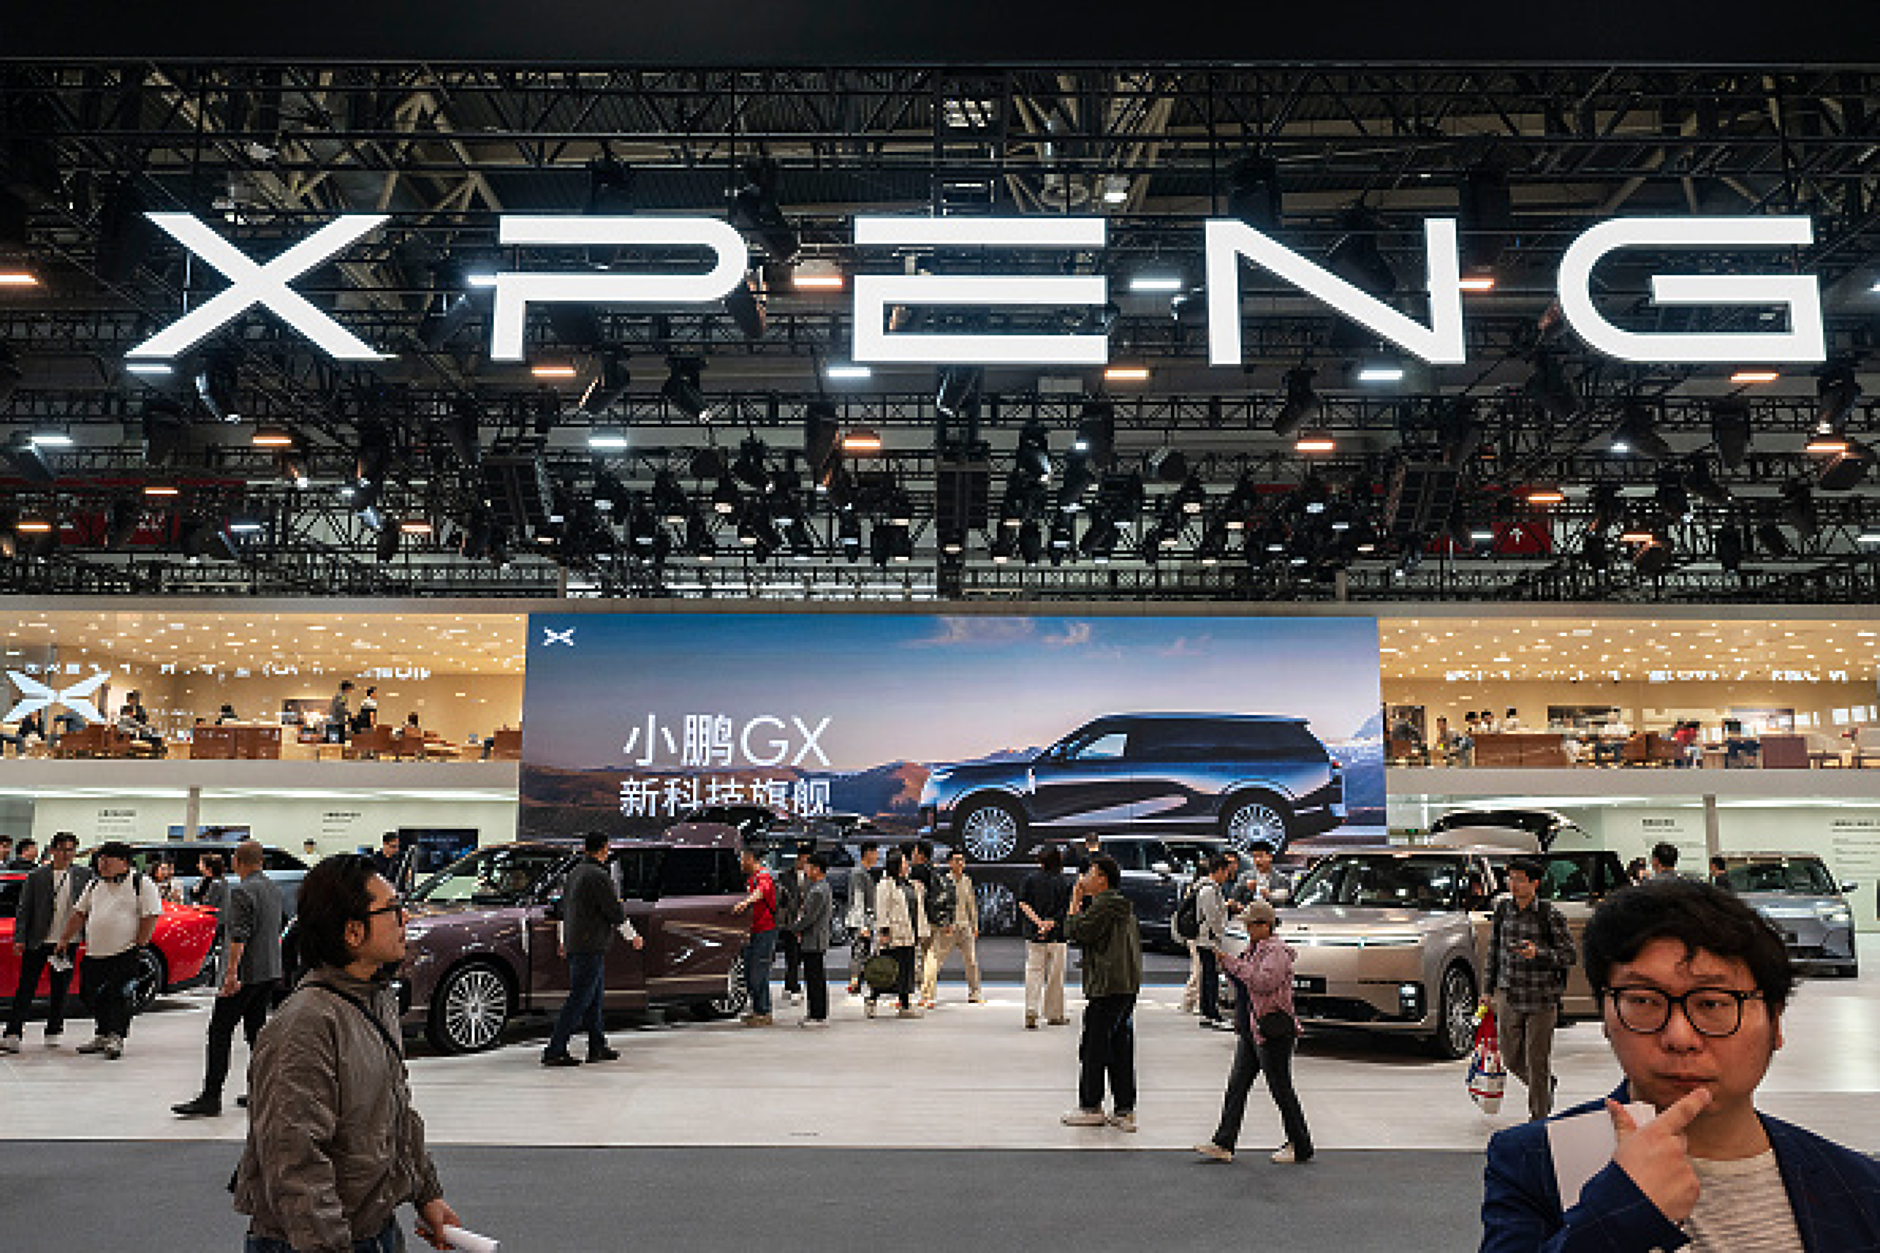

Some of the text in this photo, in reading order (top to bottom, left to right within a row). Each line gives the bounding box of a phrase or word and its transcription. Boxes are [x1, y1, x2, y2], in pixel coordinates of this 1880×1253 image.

[127, 214, 1827, 364] XPENG
[623, 712, 833, 767] 小鹏GX
[619, 777, 831, 817] 新科技旗舰
